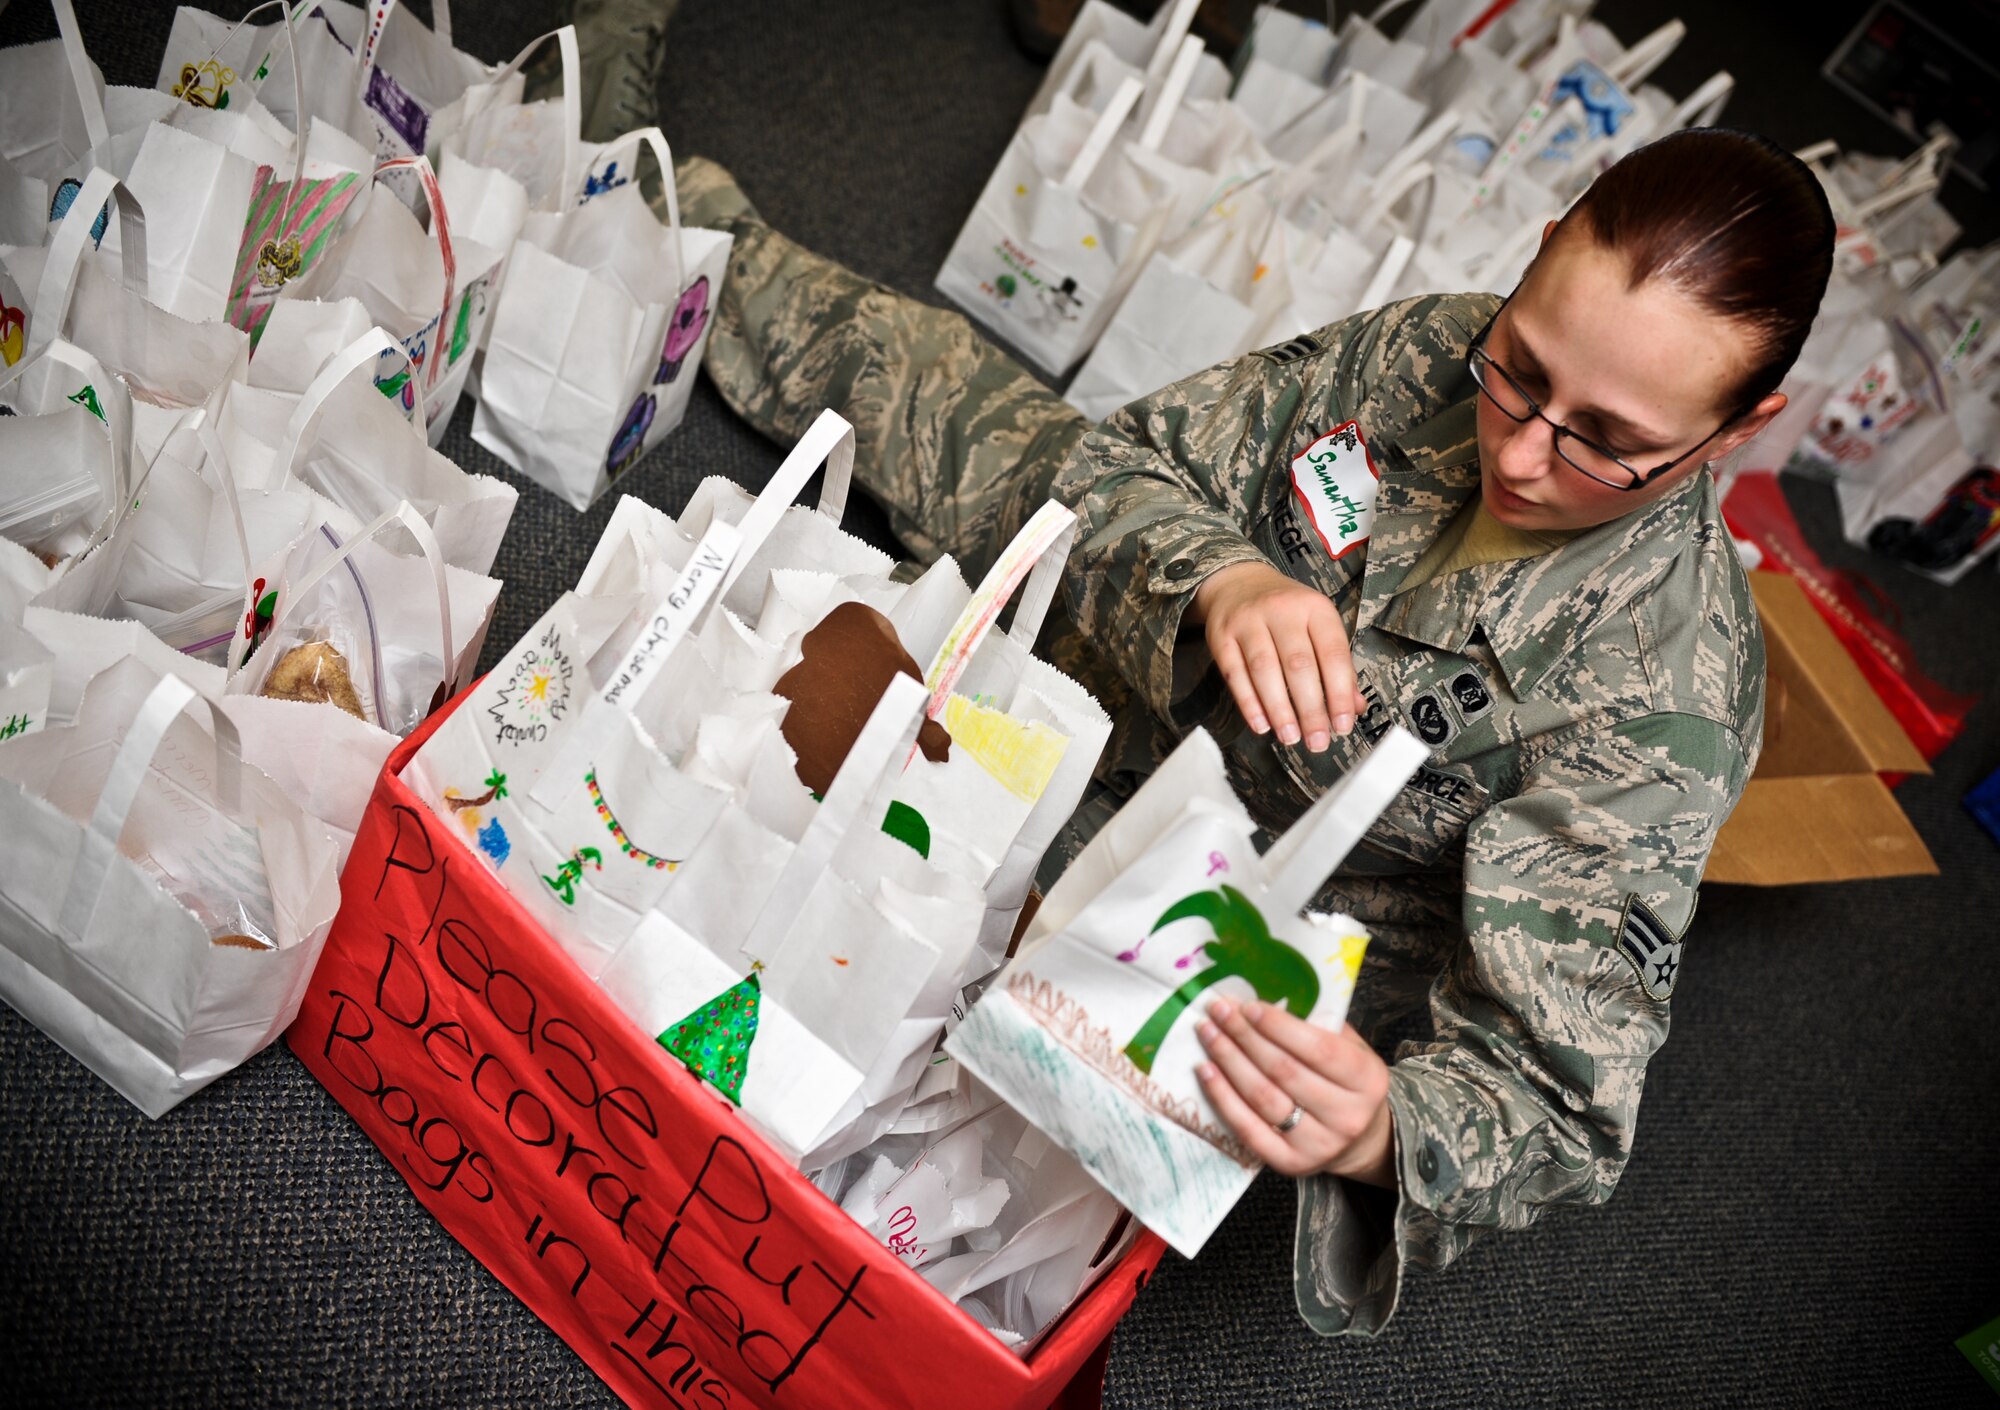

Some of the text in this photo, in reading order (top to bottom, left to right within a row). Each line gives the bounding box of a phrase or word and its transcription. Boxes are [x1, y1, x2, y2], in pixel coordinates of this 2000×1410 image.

[1273, 510, 1312, 565] EGE
[1307, 451, 1367, 540] Samantha
[604, 544, 723, 705] Merry Christmas
[324, 989, 495, 1204] Bags
[525, 1213, 592, 1298] in
[374, 804, 876, 1339] Please Put
[374, 932, 821, 1395] Decorated
